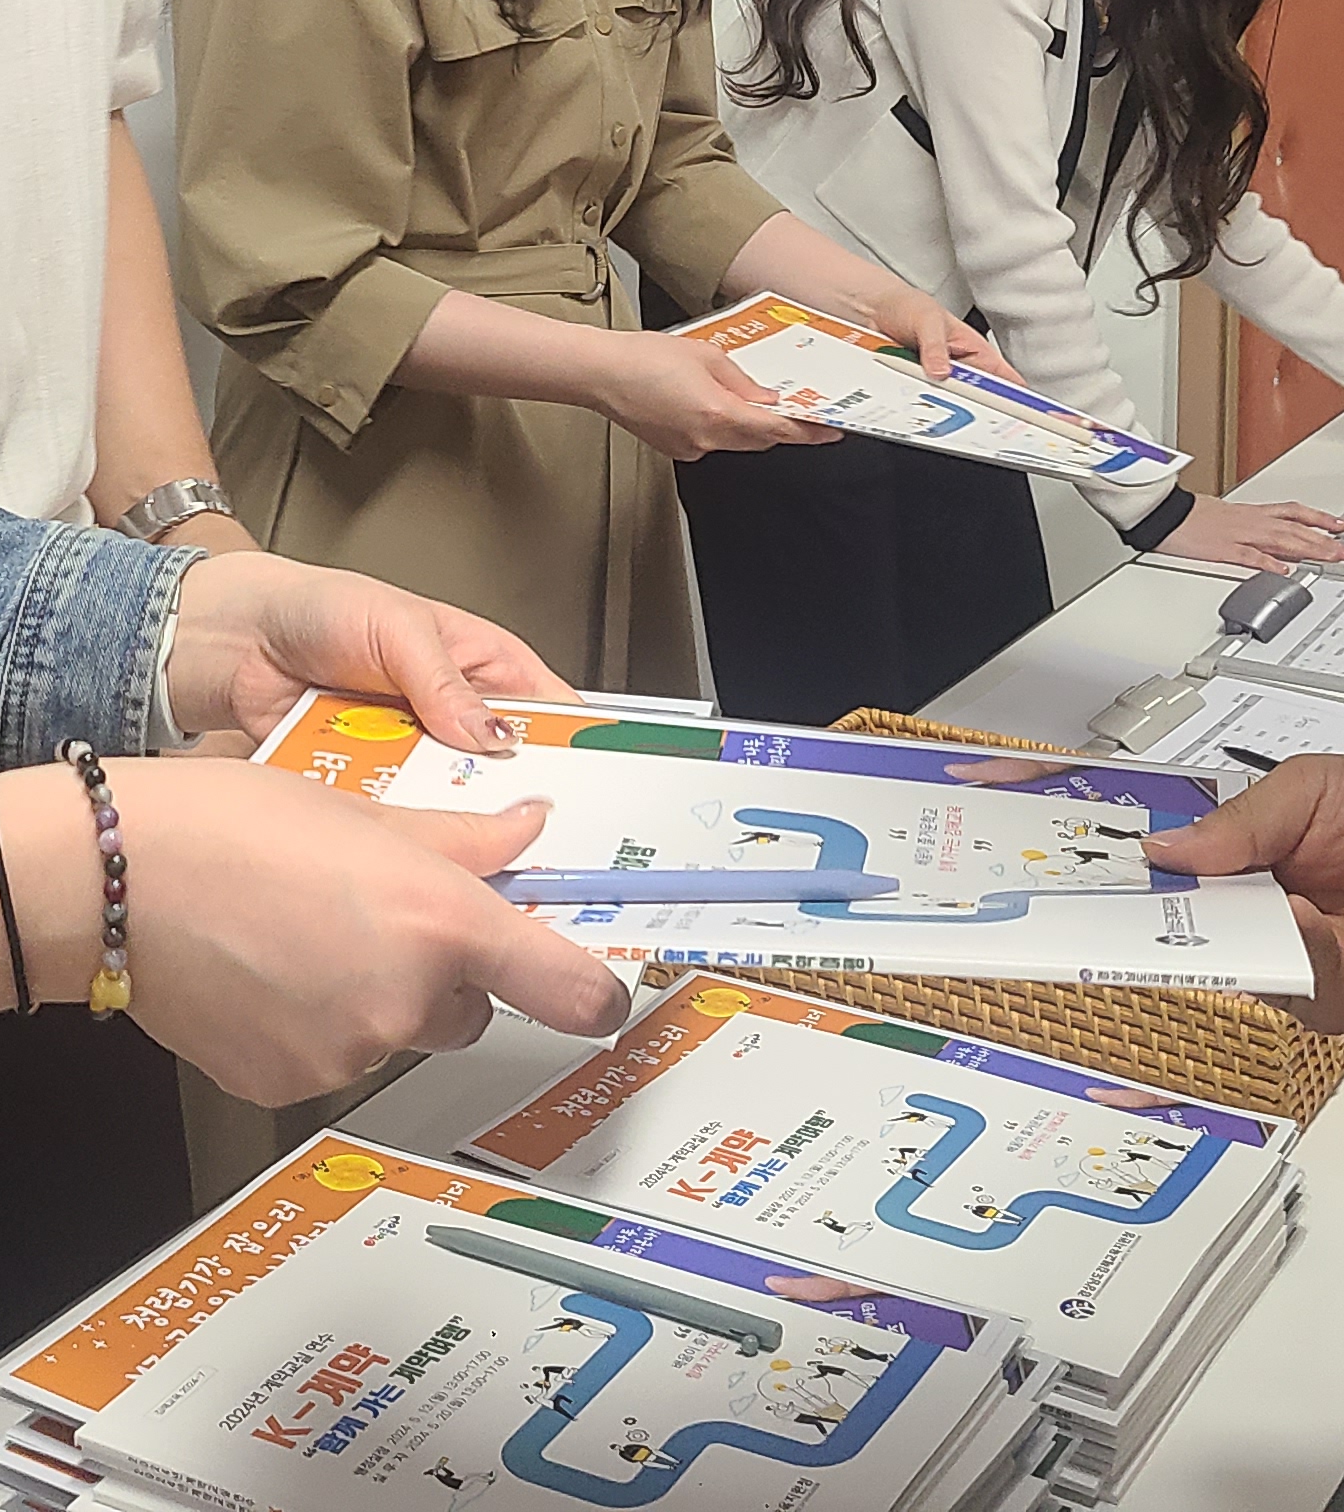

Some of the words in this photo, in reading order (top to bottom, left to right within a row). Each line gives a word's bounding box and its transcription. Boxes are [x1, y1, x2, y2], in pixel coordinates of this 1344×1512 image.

[551, 1064, 638, 1120] 청렴기강
[638, 1162, 677, 1189] 2024년
[668, 1129, 770, 1202] K-계약
[745, 1158, 788, 1183] 가는
[119, 1254, 234, 1331] 청렴기강
[219, 1391, 269, 1431] 2024년
[260, 1351, 314, 1392] 계약교실
[304, 1333, 335, 1353] 연수
[254, 1345, 388, 1448] K-계약
[303, 1416, 368, 1458] “함께
[351, 1384, 405, 1419] 가는
[390, 1316, 470, 1384] 계약여행”
